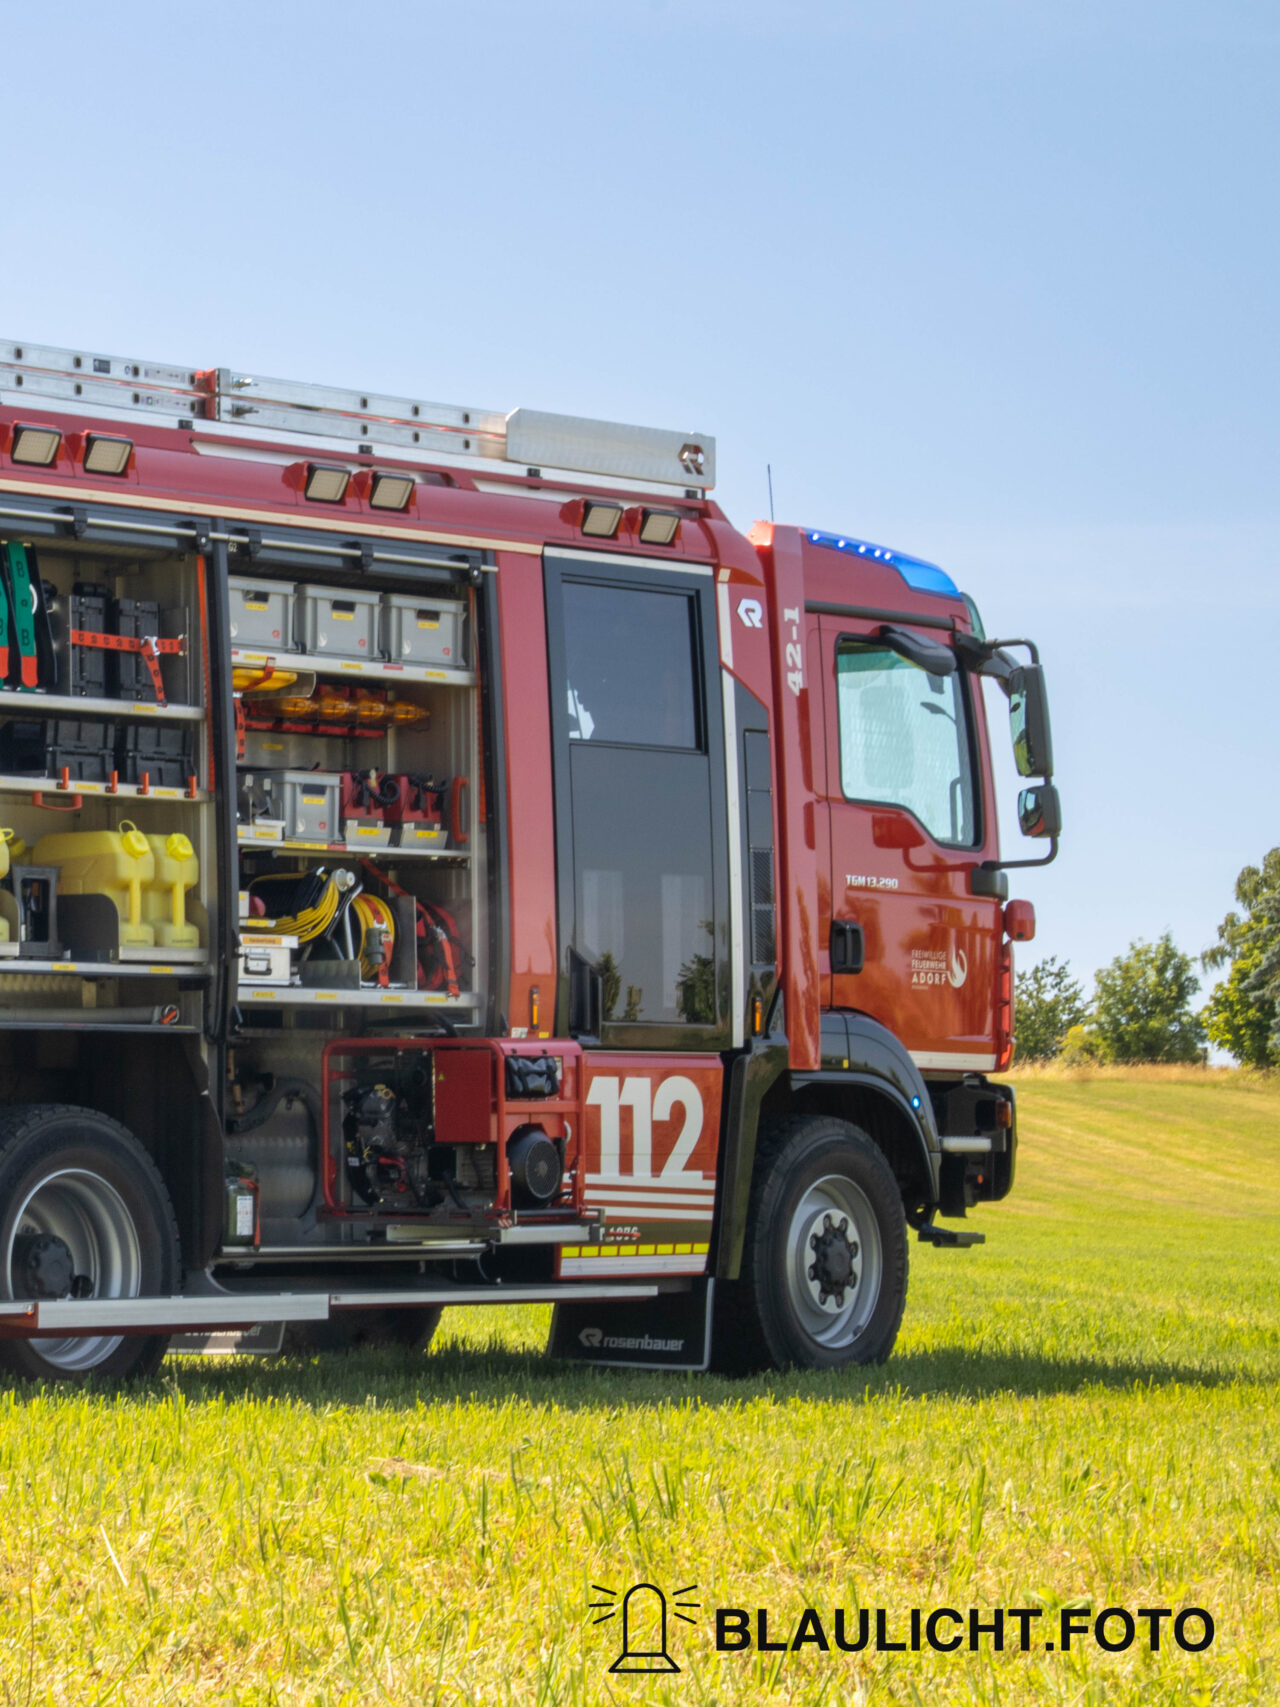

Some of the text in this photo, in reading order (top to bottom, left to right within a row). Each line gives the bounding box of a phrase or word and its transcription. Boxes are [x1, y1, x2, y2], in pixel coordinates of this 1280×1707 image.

[784, 607, 803, 696] 42-1
[911, 972, 947, 984] ADORF
[585, 1075, 705, 1179] 112
[603, 1334, 685, 1351] rosenbauer
